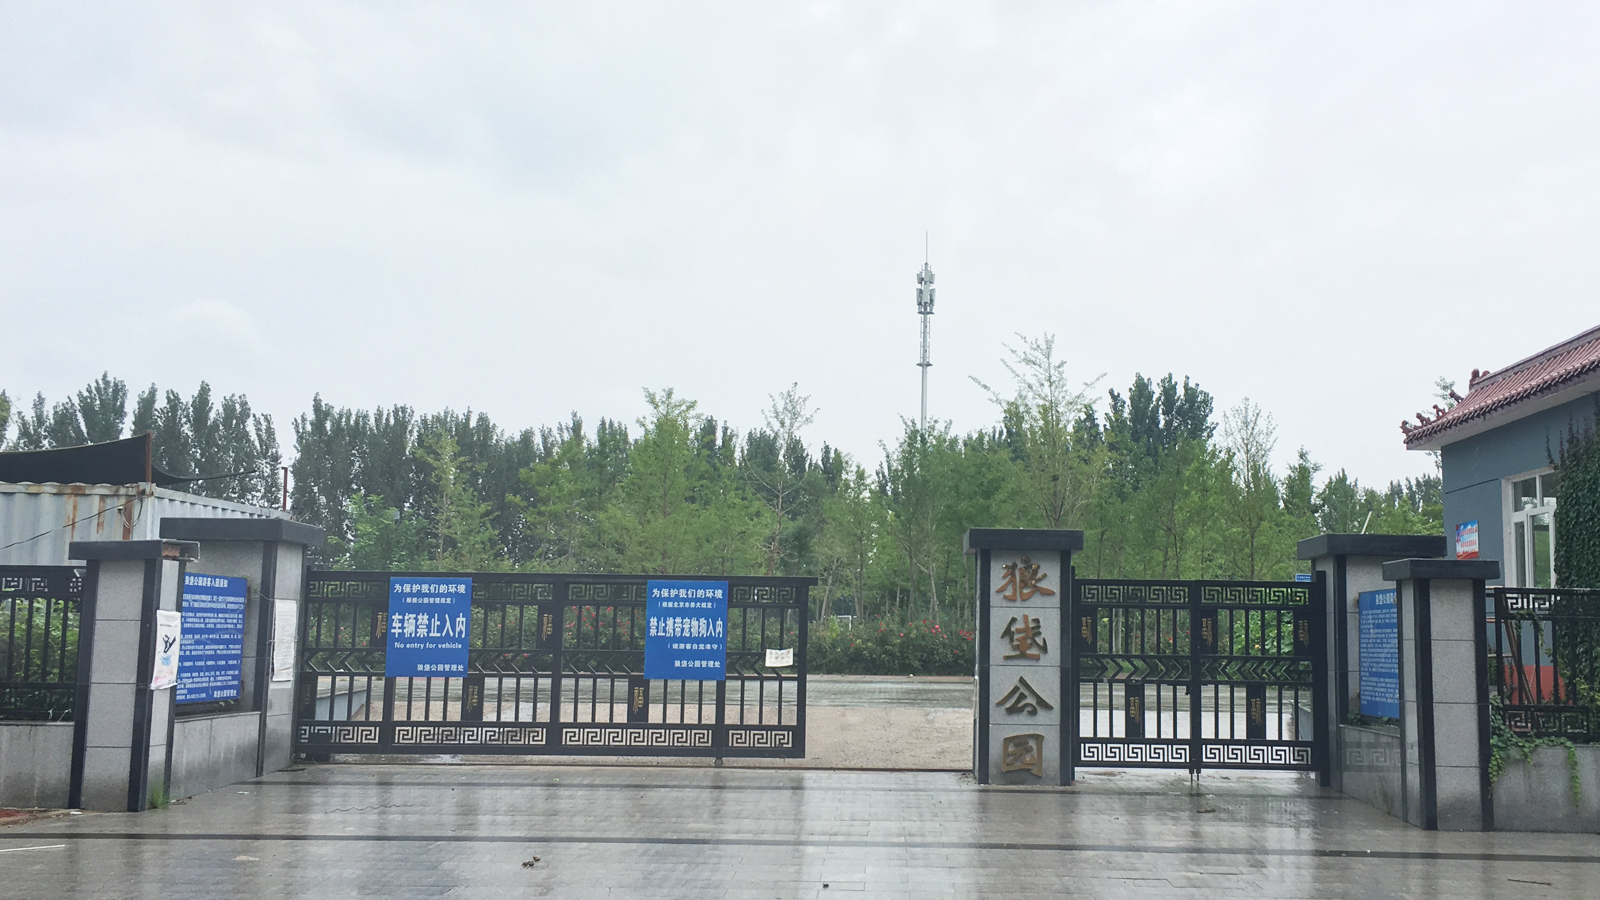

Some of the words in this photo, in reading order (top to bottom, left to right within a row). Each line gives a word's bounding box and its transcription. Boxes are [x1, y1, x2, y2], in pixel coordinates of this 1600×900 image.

[393, 583, 467, 594] 为保护我们的环境
[651, 587, 723, 599] 为保护我们的环境
[390, 612, 467, 639] 车辆禁止入内
[648, 616, 723, 638] 禁止携带宠物狗入内
[394, 641, 405, 649] No
[406, 642, 425, 650] entry
[425, 641, 436, 649] for
[438, 641, 462, 649] vehicle
